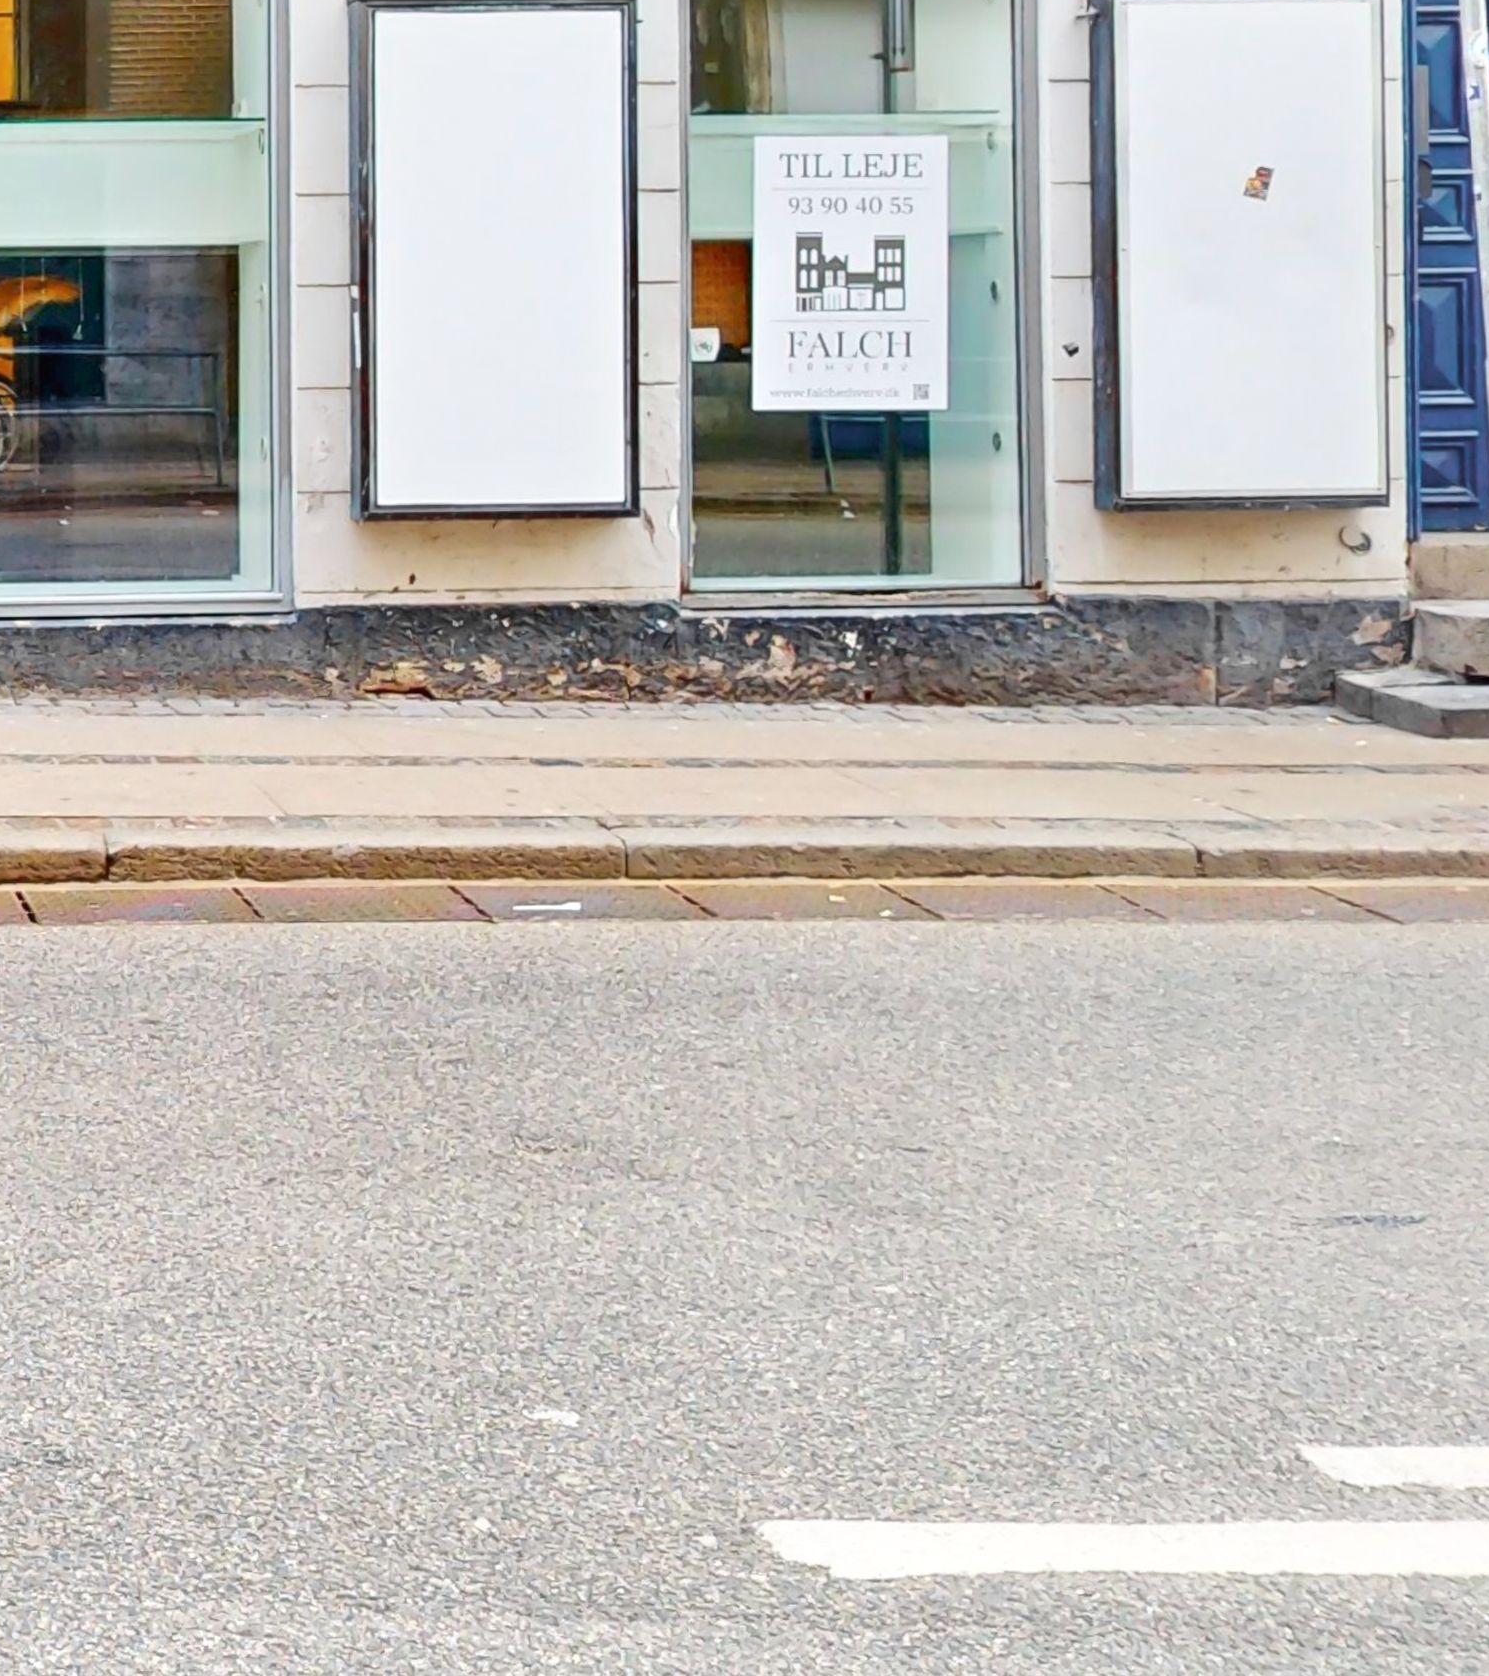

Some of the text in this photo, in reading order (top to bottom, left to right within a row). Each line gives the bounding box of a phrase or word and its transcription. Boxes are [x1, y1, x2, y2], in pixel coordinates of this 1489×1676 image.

[779, 153, 923, 178] TIL LEJE
[788, 197, 914, 215] 93 90 40 55
[787, 330, 913, 359] FALCH
